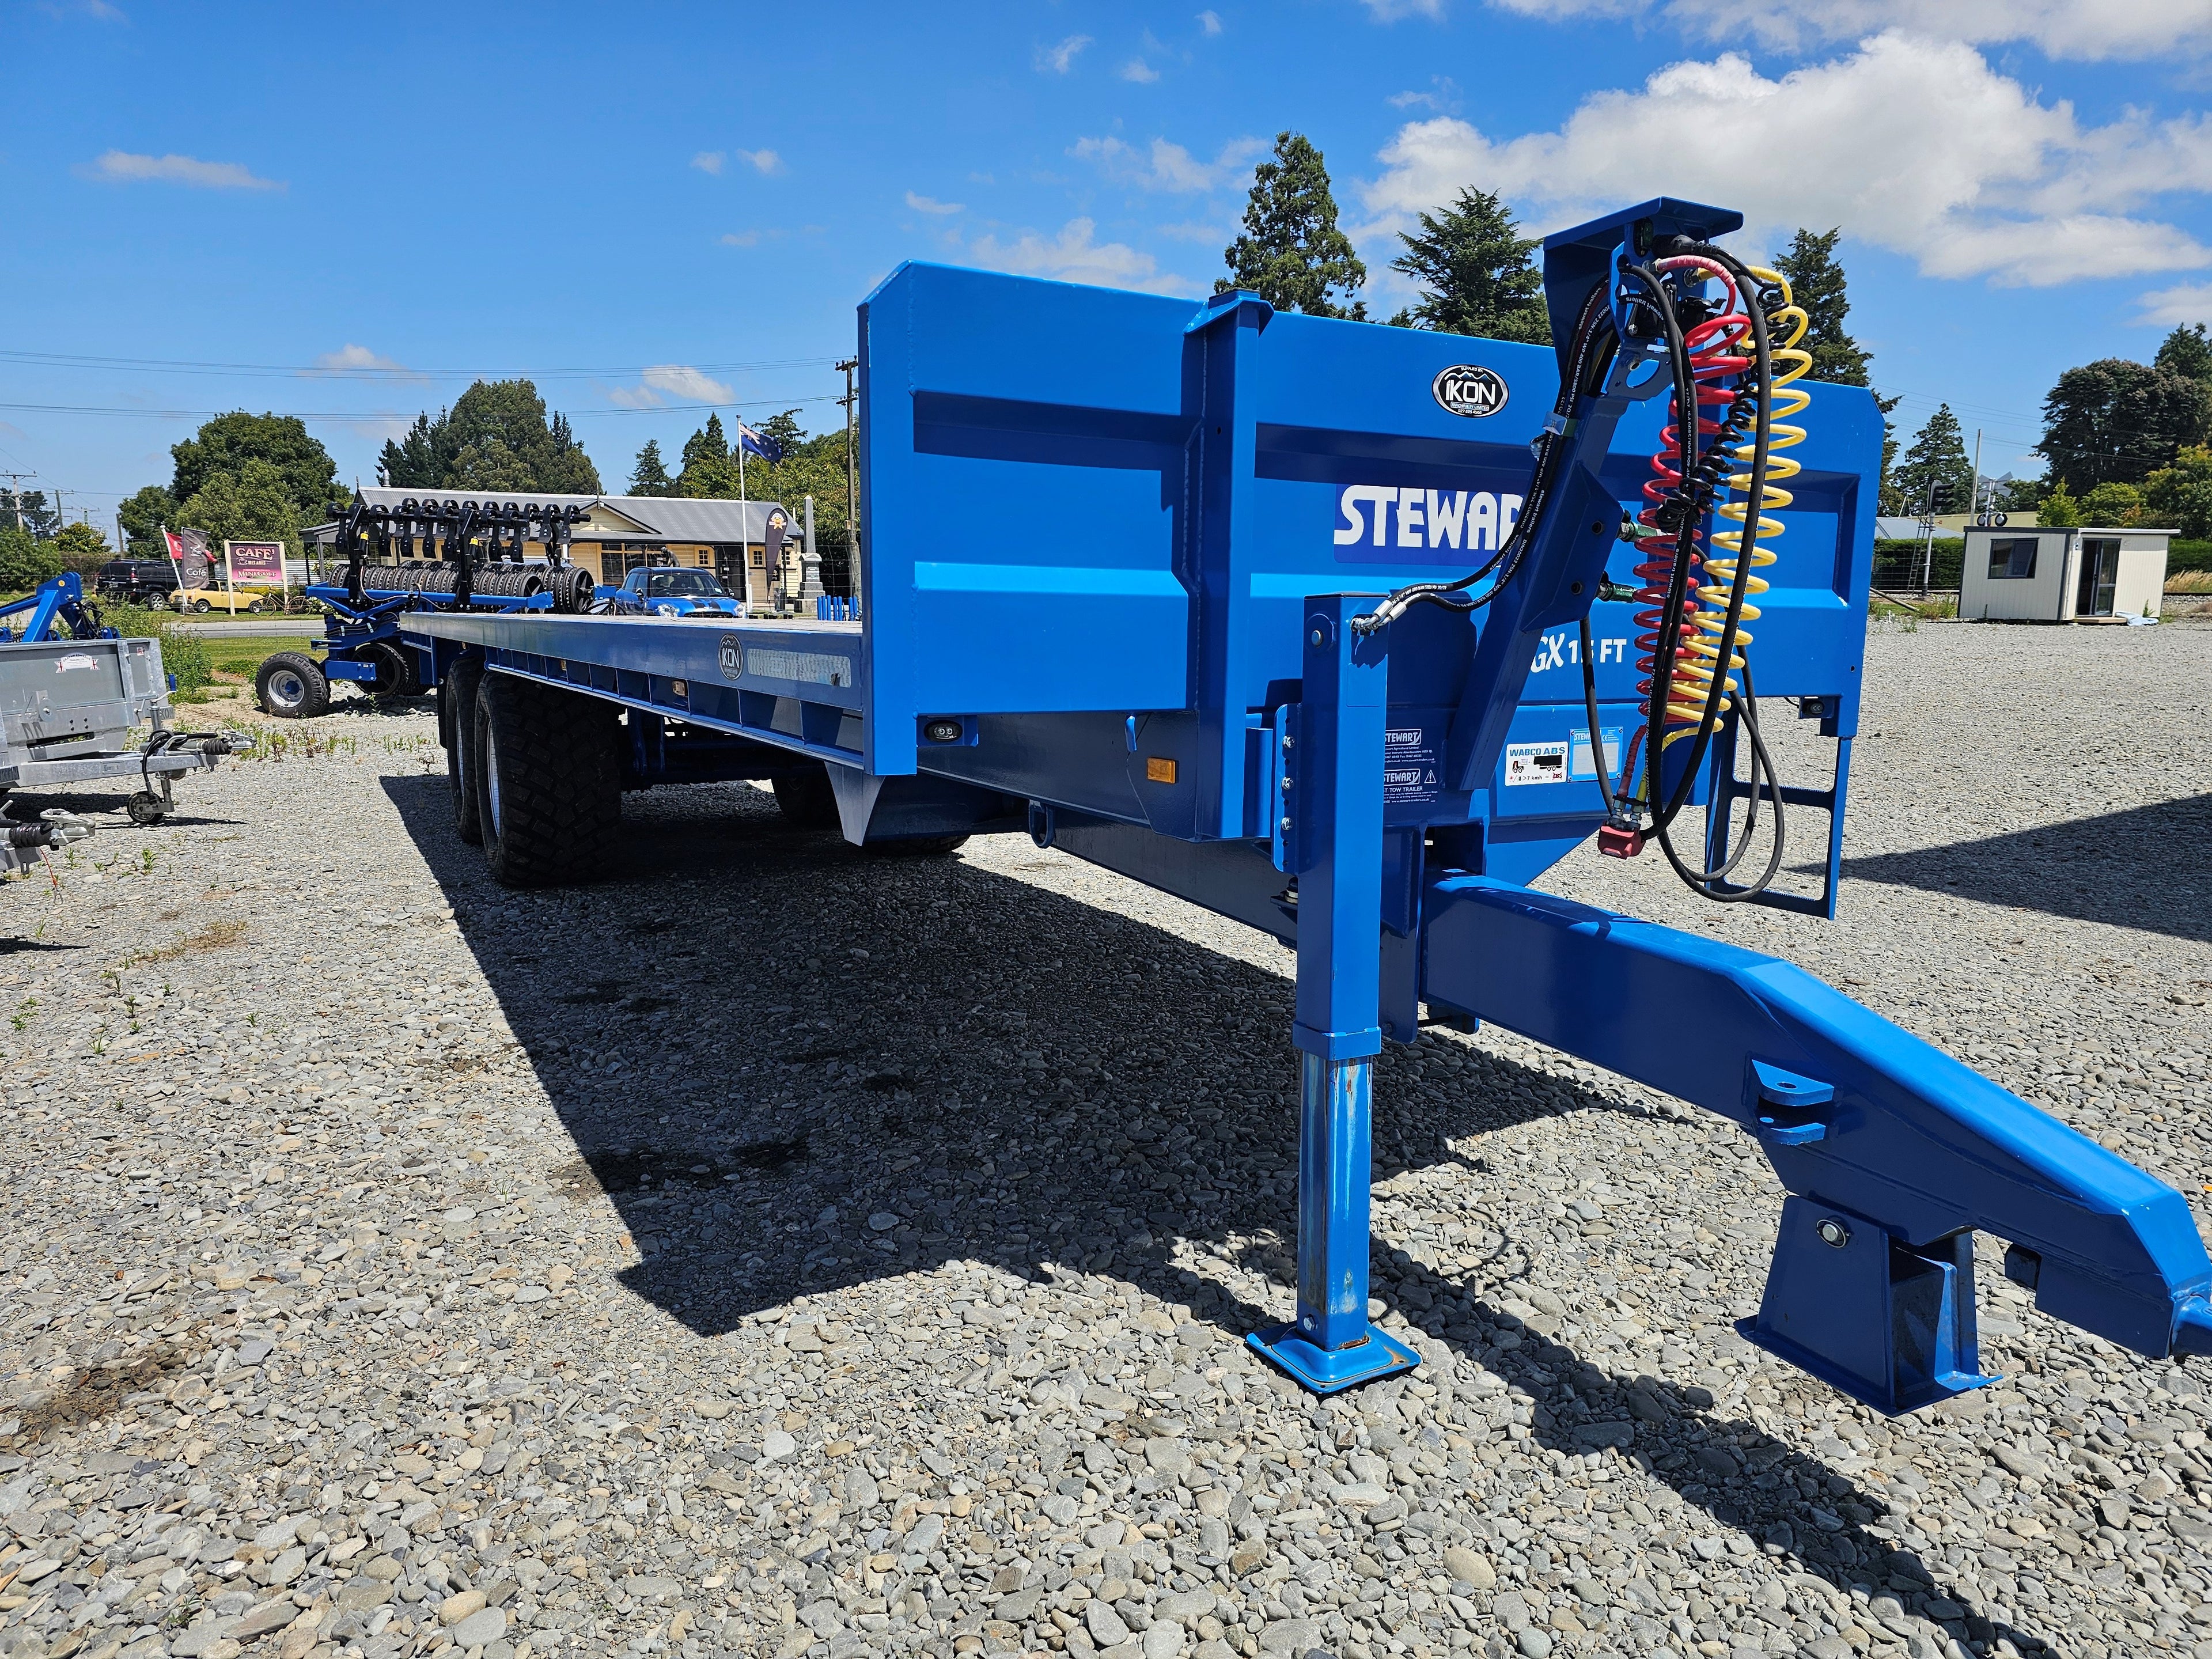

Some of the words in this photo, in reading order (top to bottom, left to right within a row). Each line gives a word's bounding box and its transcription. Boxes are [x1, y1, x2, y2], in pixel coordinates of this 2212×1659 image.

[1626, 297, 1646, 306] trailers
[1581, 343, 1588, 353] WP
[1445, 380, 1496, 405] IKON
[1334, 484, 1524, 551] STEWAR
[1600, 639, 1627, 663] FT
[1509, 748, 1541, 757] WABCO
[1543, 747, 1566, 755] ABS
